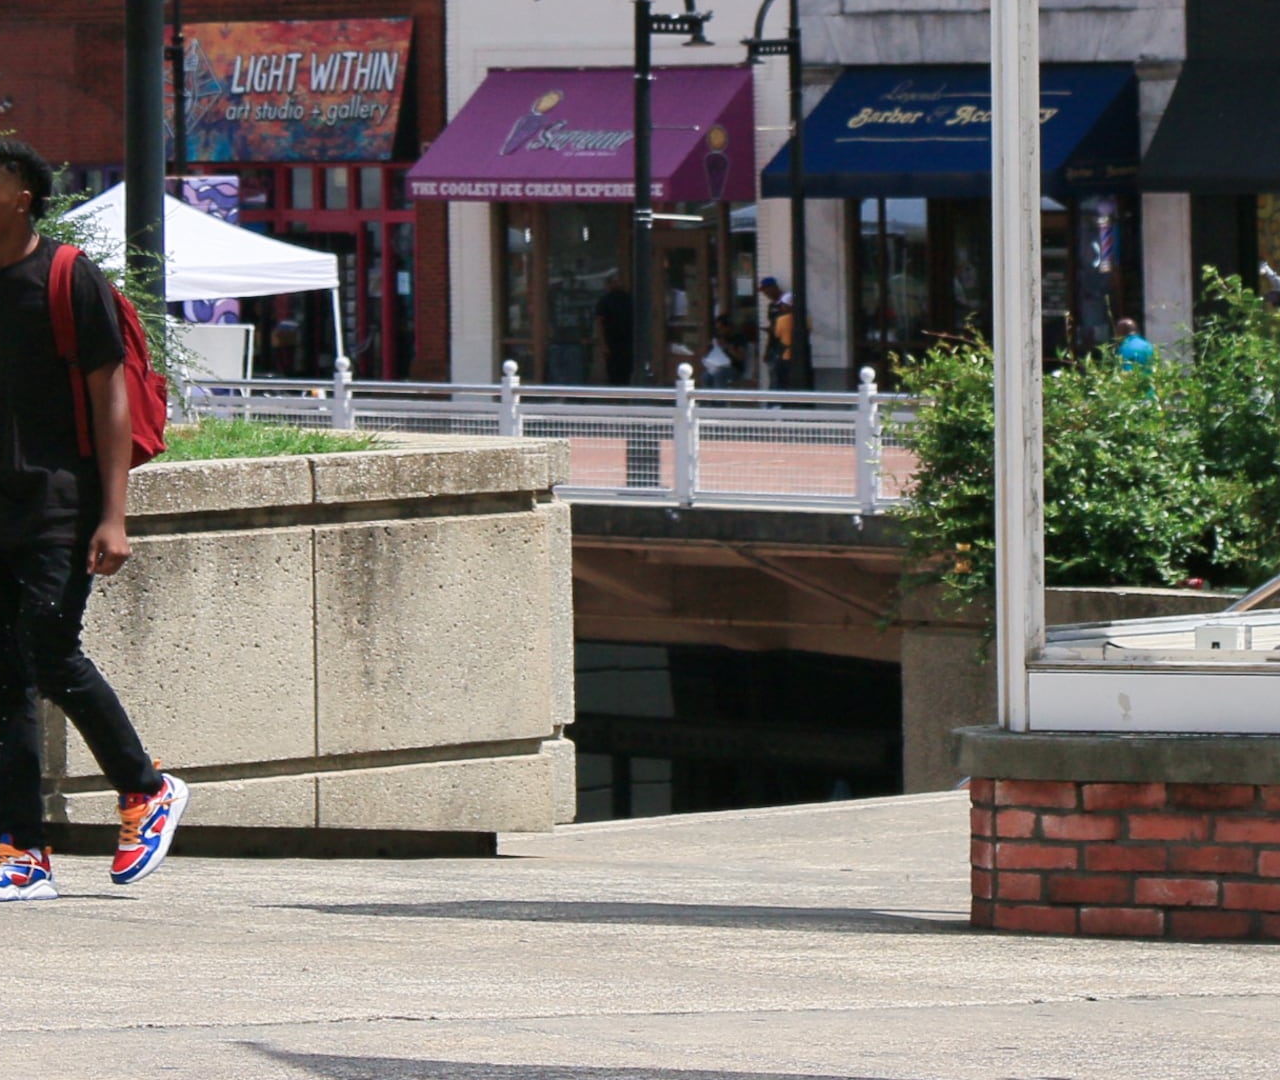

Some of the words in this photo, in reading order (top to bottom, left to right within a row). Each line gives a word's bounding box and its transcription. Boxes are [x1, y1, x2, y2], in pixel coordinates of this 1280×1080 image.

[231, 53, 303, 94] LIGHT
[310, 51, 399, 93] WITHIN
[225, 100, 251, 121] art
[255, 97, 304, 120] studio
[327, 95, 390, 126] gallery
[847, 107, 923, 129] Barber
[412, 182, 437, 197] THE
[440, 182, 498, 197] COOLEST
[500, 182, 522, 197] ICE
[525, 182, 572, 197] CREAM
[575, 182, 663, 197] EXPERIEE
